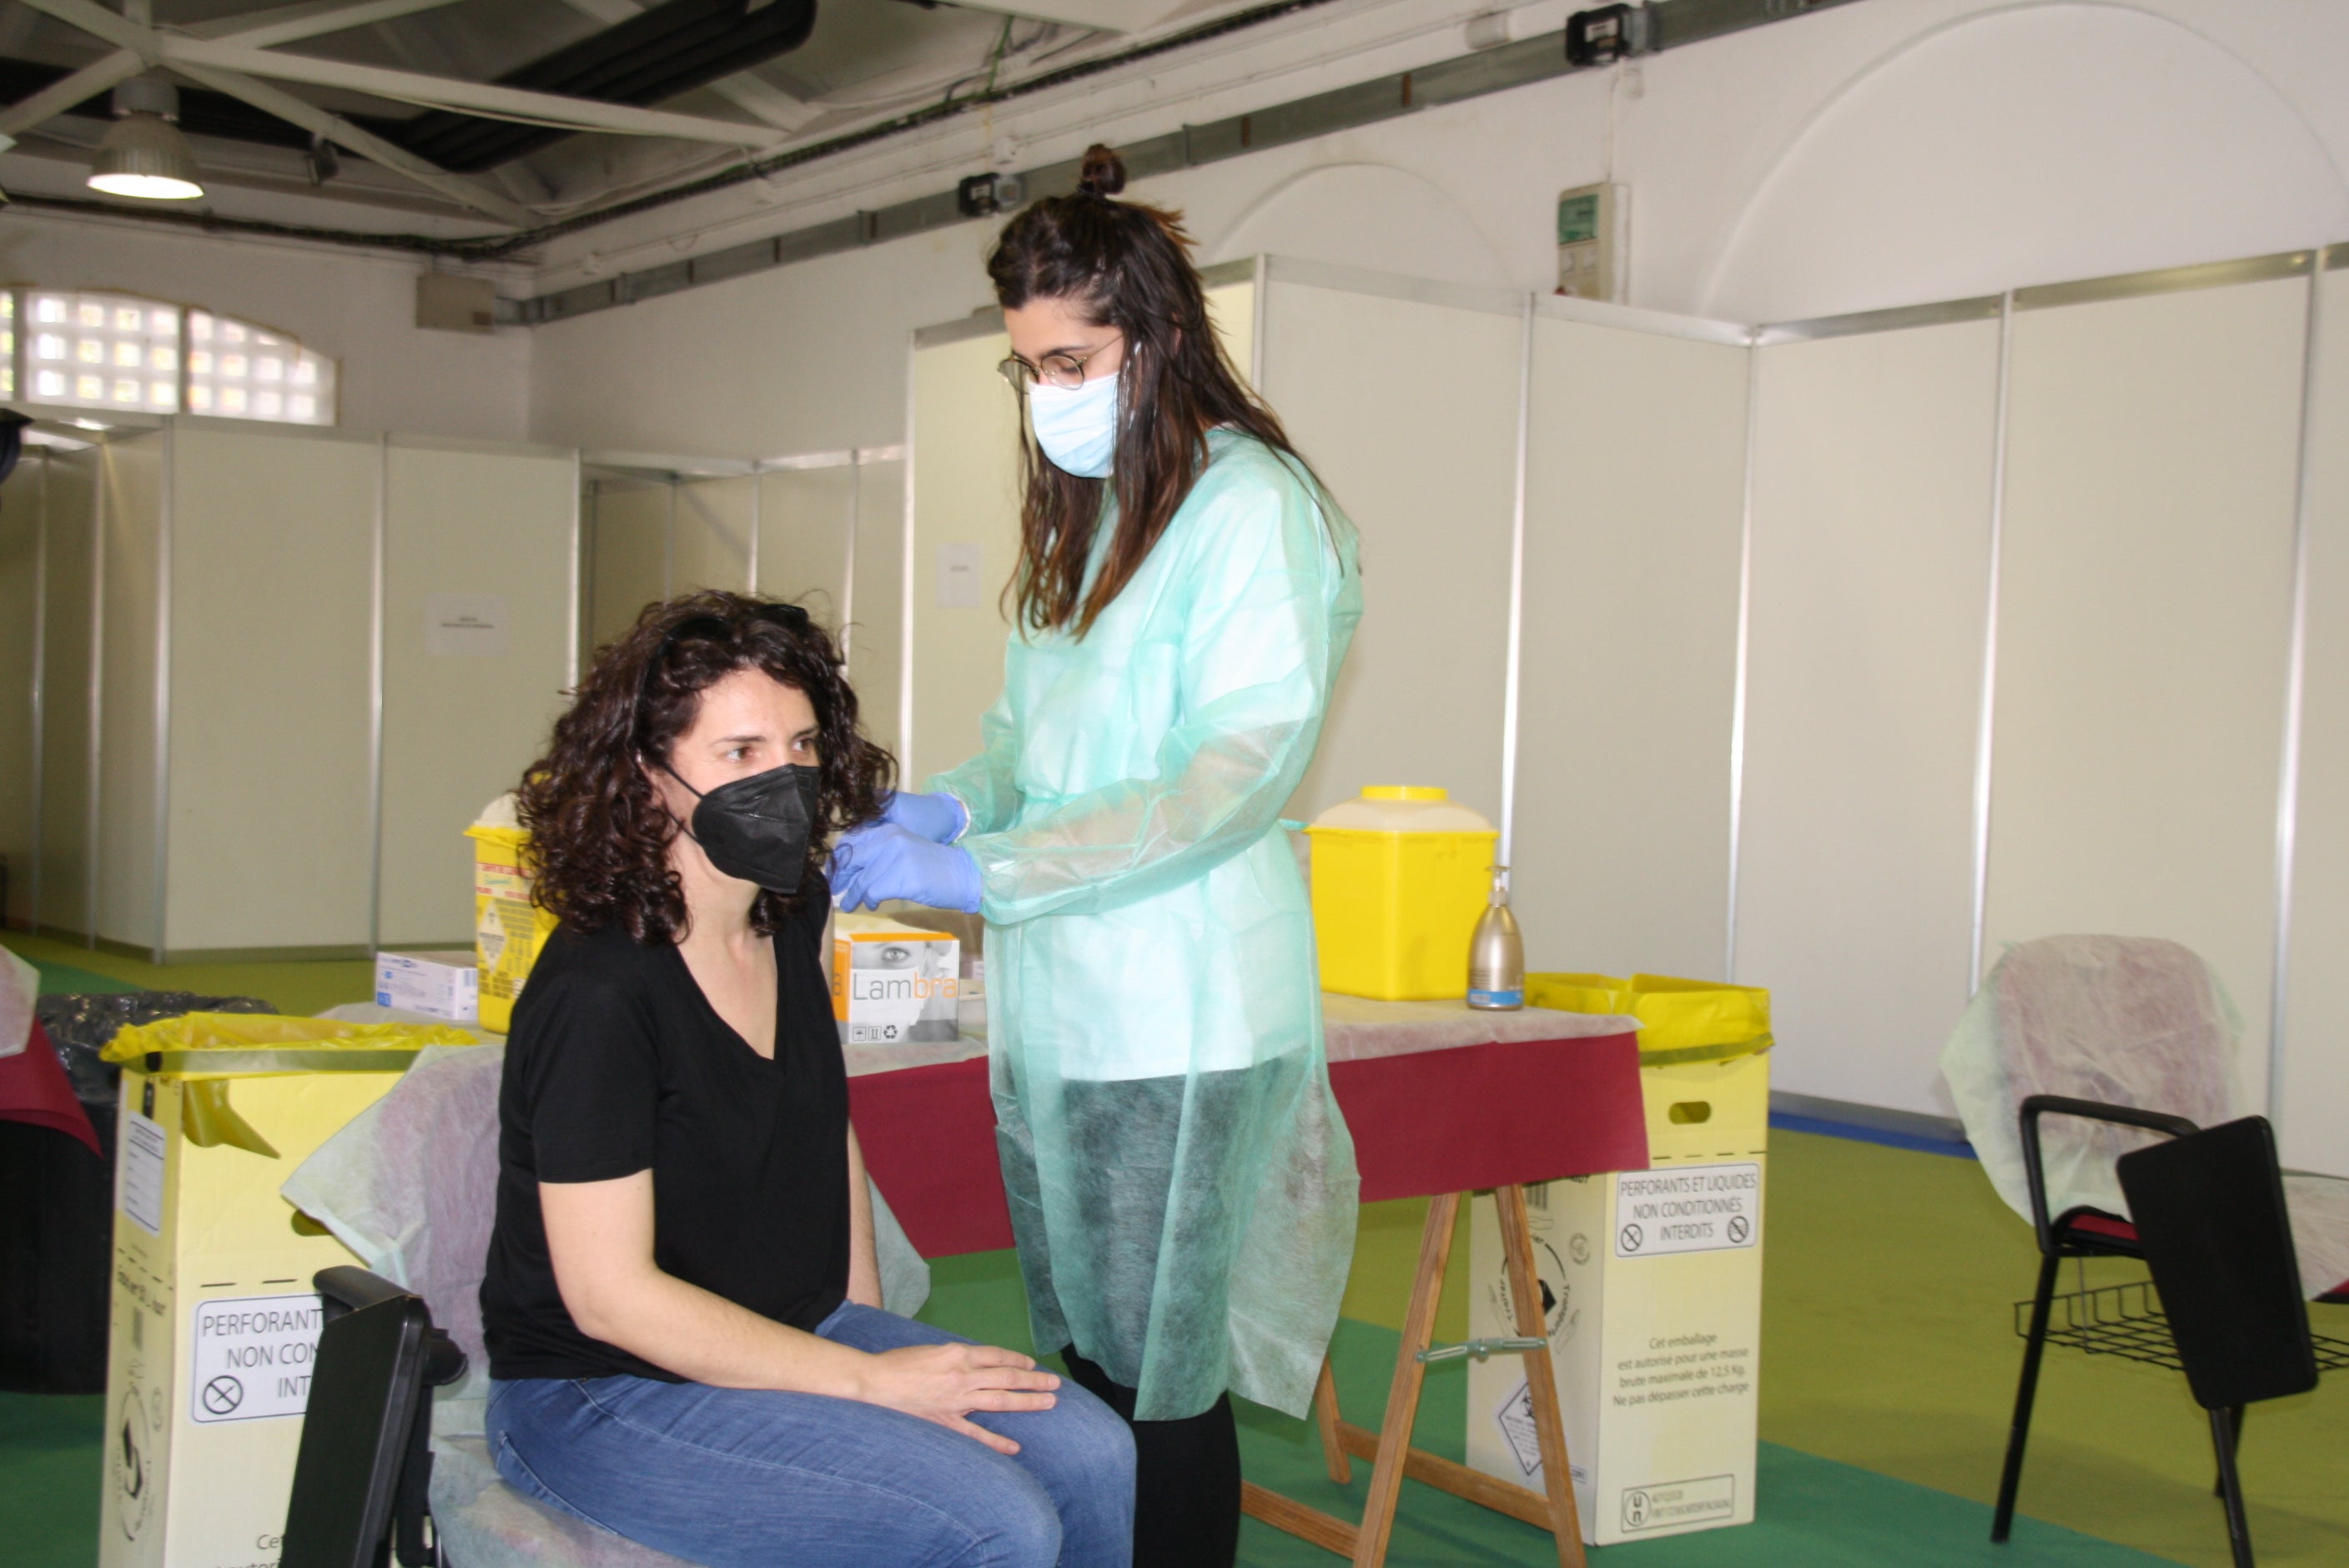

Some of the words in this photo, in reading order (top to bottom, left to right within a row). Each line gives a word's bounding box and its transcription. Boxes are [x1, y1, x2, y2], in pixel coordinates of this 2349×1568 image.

[853, 971, 958, 1001] Lambra
[1621, 1177, 1690, 1197] PERFORANTS
[1693, 1176, 1705, 1193] ET
[1708, 1173, 1756, 1192] LIQUIDES
[1633, 1204, 1658, 1219] NON
[1661, 1222, 1714, 1241] INTERDITS
[227, 1344, 274, 1369] NON
[257, 1534, 284, 1550] Ce
